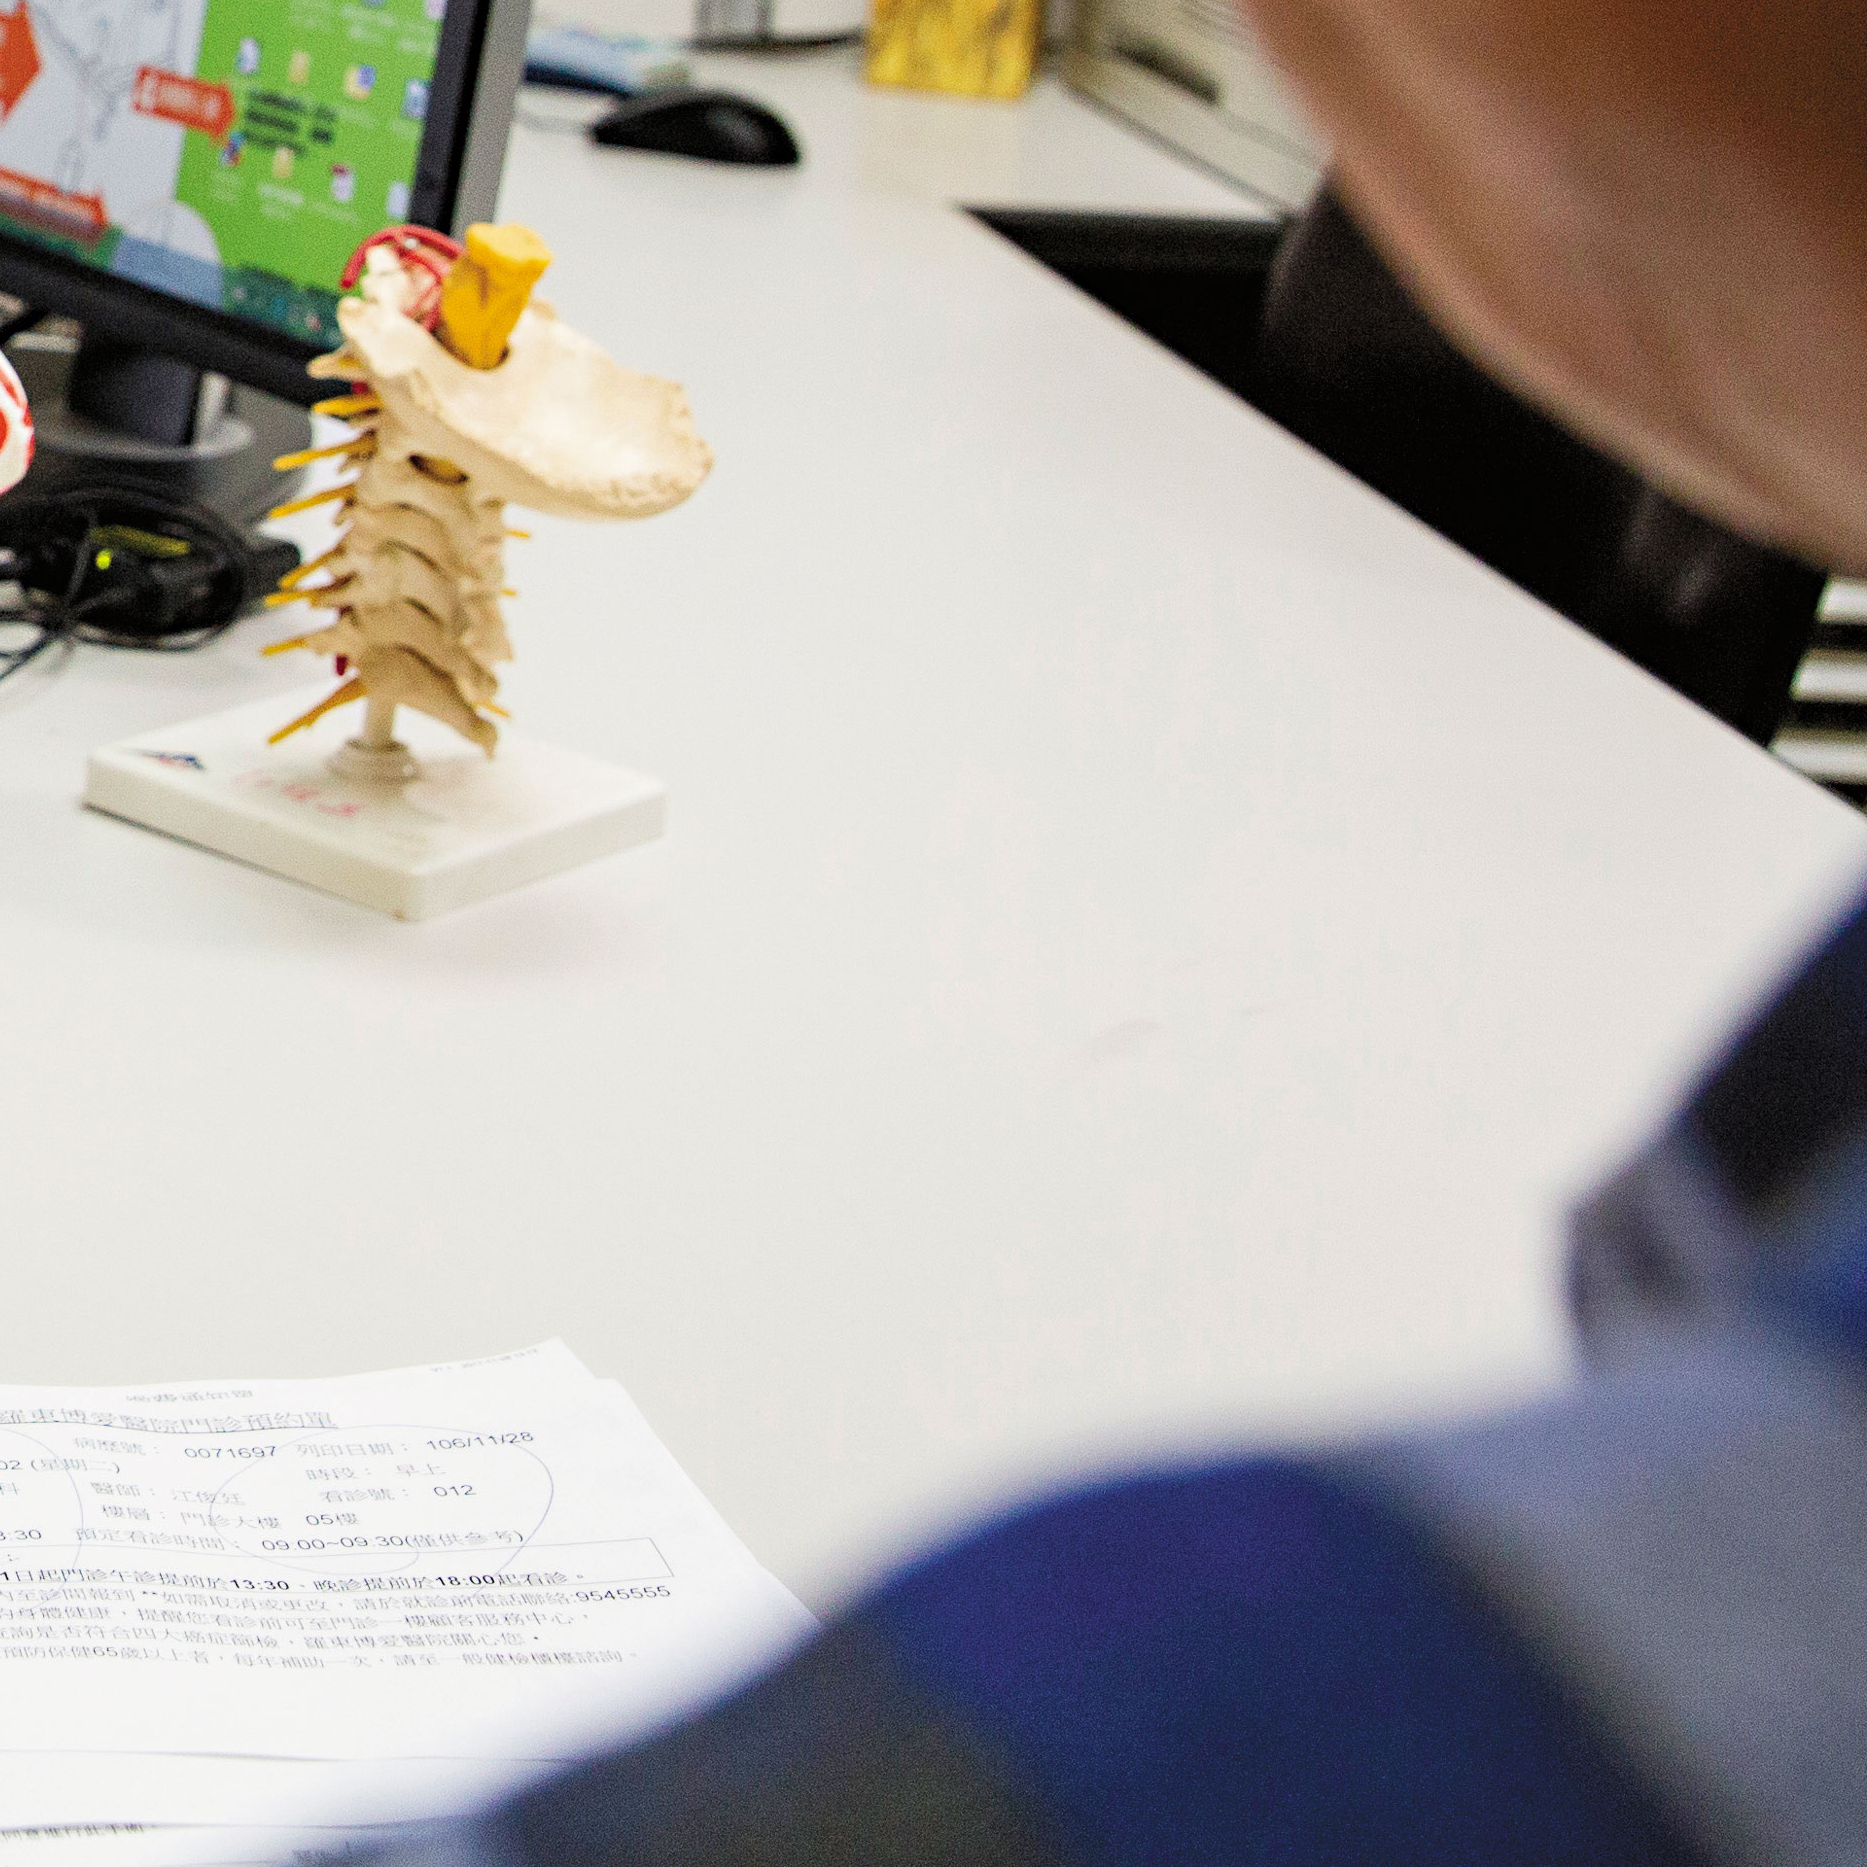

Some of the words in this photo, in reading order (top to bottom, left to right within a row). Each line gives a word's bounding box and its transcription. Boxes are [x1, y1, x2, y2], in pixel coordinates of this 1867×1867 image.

[183, 1445, 277, 1459] 0071697
[425, 1431, 536, 1451] 106/11/28
[432, 1484, 477, 1497] 012
